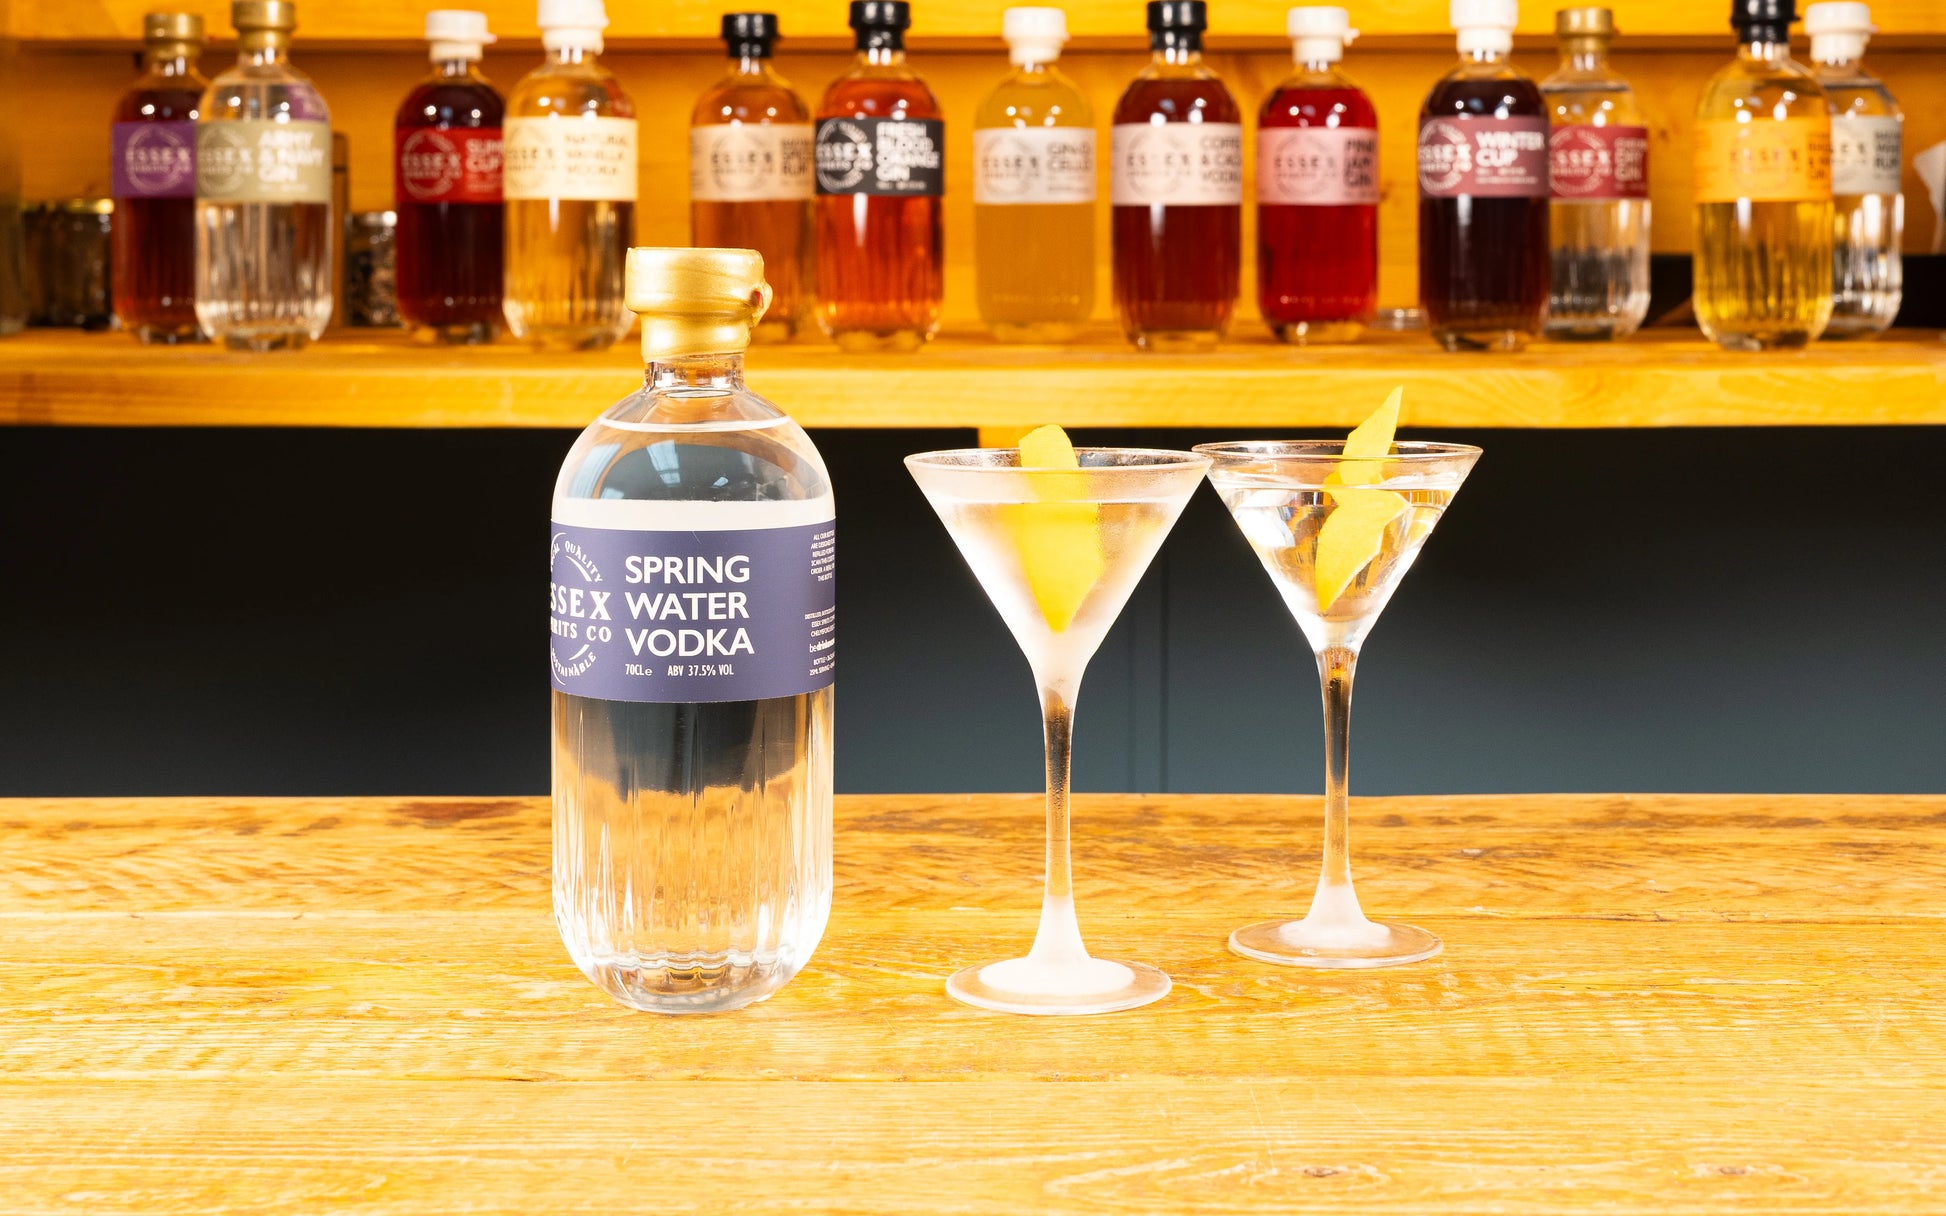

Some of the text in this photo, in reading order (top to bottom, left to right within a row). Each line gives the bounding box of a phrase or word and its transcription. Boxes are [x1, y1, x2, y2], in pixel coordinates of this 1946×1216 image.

[1474, 131, 1545, 150] WINTER
[1475, 149, 1518, 168] CUP
[564, 540, 603, 583] QUALITY
[625, 555, 750, 584] SPRING
[624, 591, 750, 620] WATER
[586, 625, 612, 643] CO
[624, 627, 755, 657] VODKA
[667, 665, 684, 676] ABV
[688, 664, 716, 676] 37.5%
[718, 664, 734, 675] VOL
